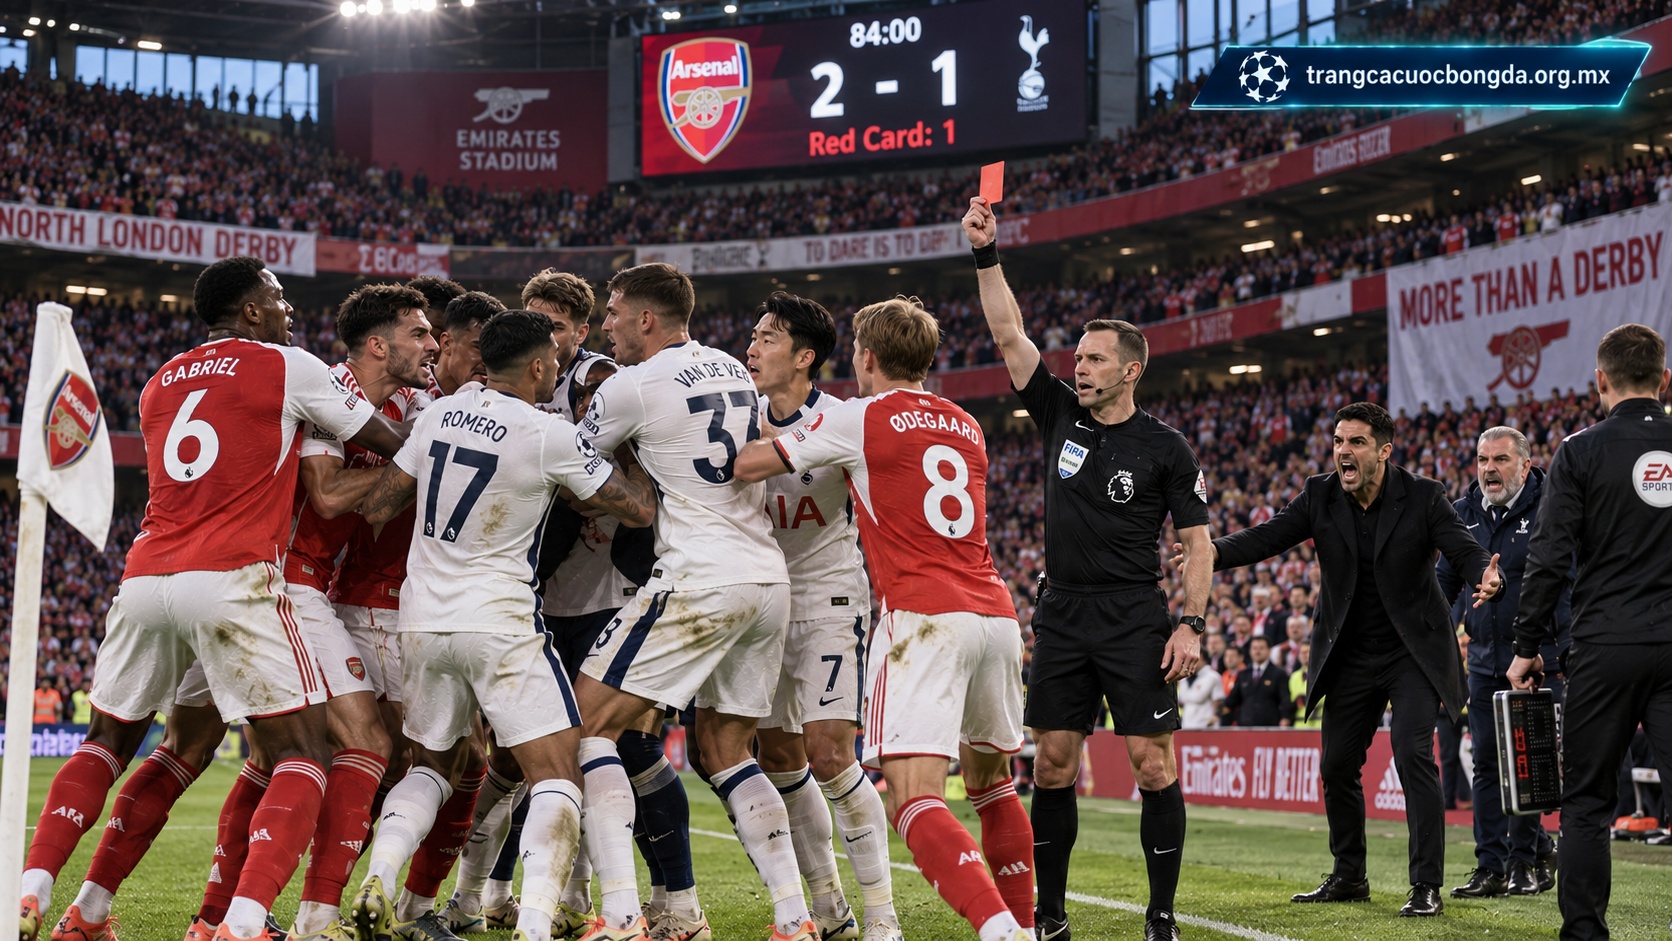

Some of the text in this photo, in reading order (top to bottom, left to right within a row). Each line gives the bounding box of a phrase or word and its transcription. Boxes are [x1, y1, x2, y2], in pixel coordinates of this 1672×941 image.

[849, 16, 922, 49] 84:00
[671, 55, 739, 80] Arsenal
[810, 61, 845, 120] 2
[931, 49, 957, 107] 1
[456, 129, 561, 149] EMIRATES
[809, 119, 956, 157] Red Card: 1
[459, 151, 558, 172] STADIUM
[0, 207, 299, 265] NORTH LONDON DERBY
[805, 238, 824, 263] TO
[829, 236, 870, 262] DARE
[873, 234, 890, 257] IS
[894, 232, 914, 255] TO
[1399, 231, 1664, 331] MORE THAN A DERBY
[161, 357, 240, 387] GABRIEL
[674, 365, 707, 388] VAN
[702, 362, 725, 378] DE
[61, 384, 96, 428] Arsenal
[163, 388, 219, 482] 6
[440, 410, 508, 443] ROMERO
[889, 410, 979, 446] ØDEGAARD
[1643, 463, 1672, 482] EA
[424, 439, 499, 543] 17
[922, 444, 975, 539] 8
[821, 655, 843, 692] 7
[1181, 745, 1320, 803] Emirates FLY BETTER
